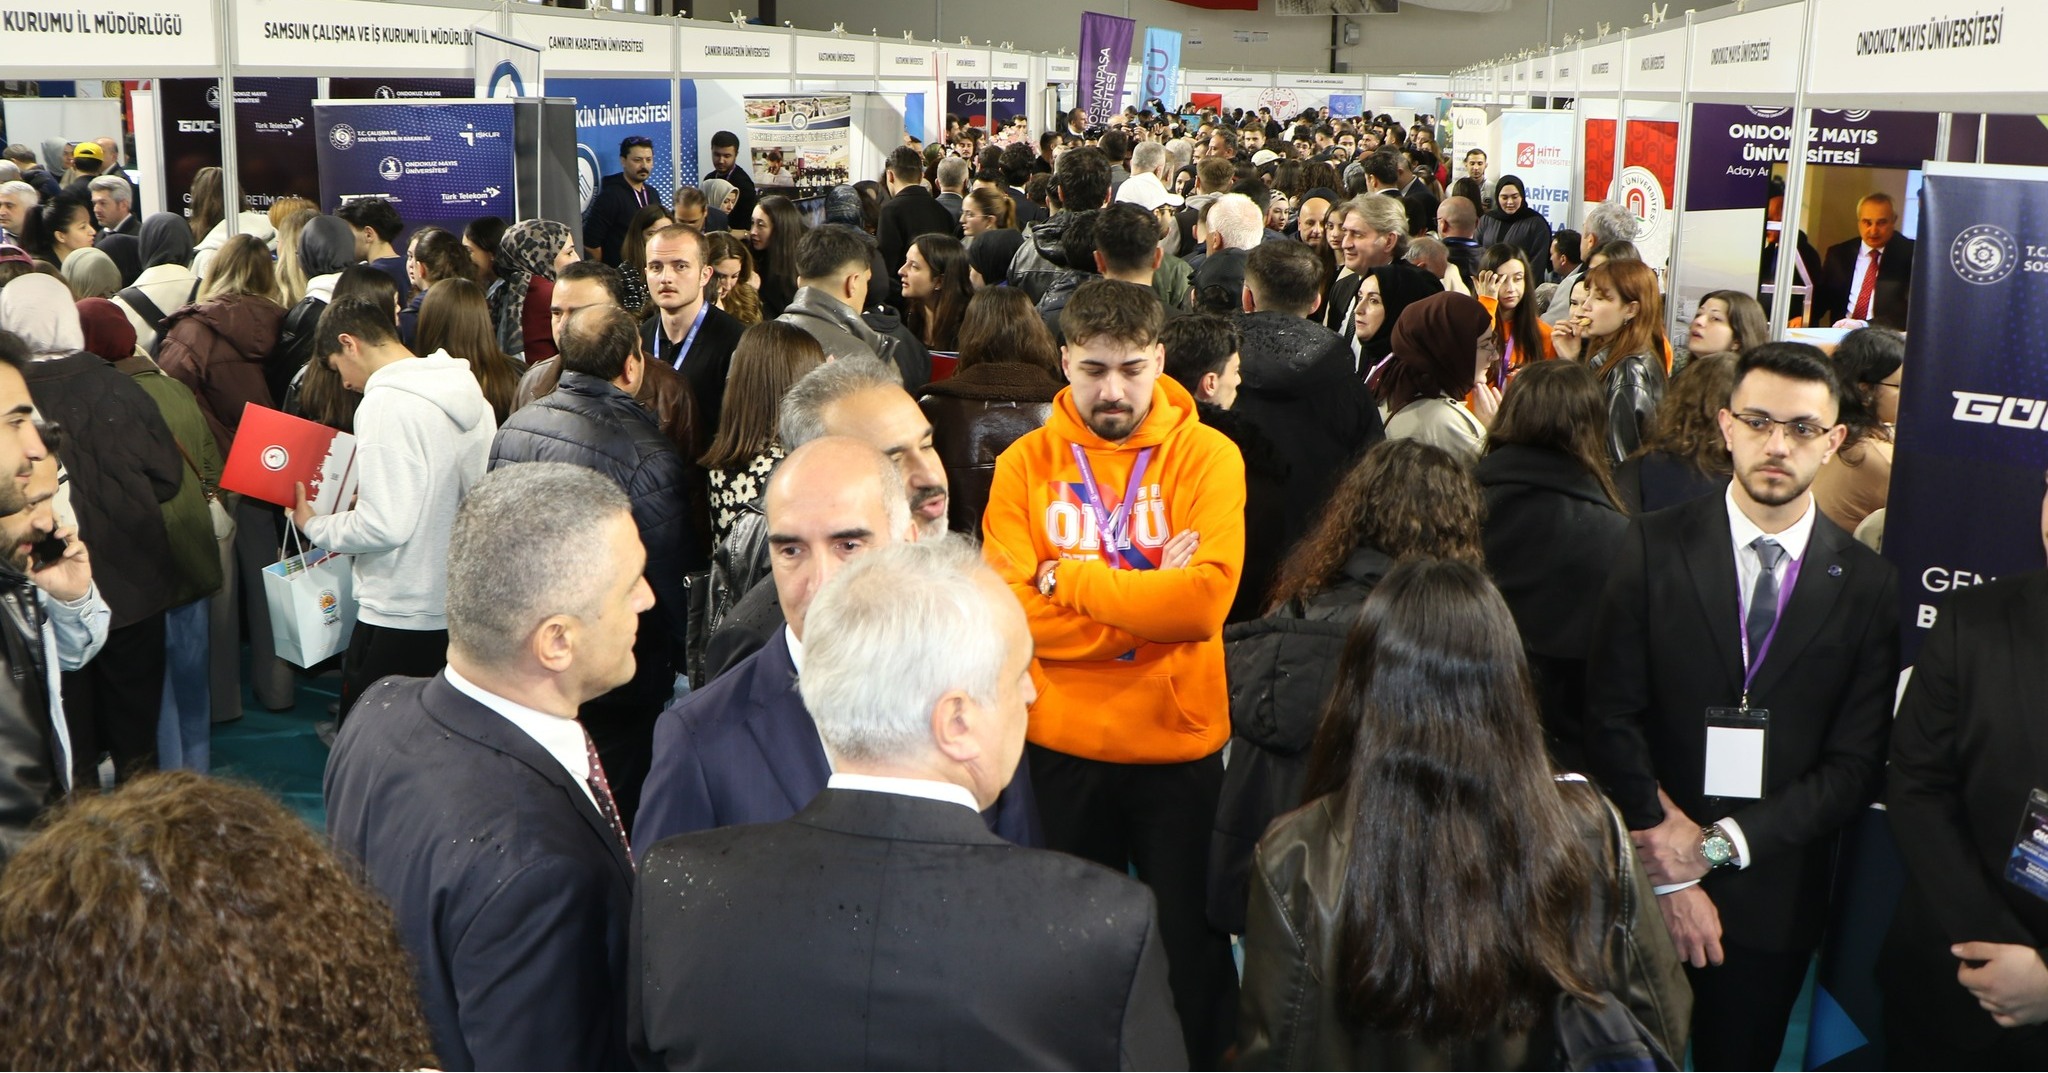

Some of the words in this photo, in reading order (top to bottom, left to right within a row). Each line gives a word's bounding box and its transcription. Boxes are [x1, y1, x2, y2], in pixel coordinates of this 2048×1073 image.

[3, 10, 74, 33] KURUMU
[77, 9, 91, 34] İL
[95, 11, 182, 36] MÜDÜRLÜĞÜ
[264, 22, 310, 40] SAMSUN
[312, 24, 356, 43] ÇALIŞMA
[357, 26, 370, 42] VE
[372, 24, 381, 44] İŞ
[382, 27, 420, 44] KURUMU
[421, 26, 429, 44] İL
[1856, 27, 1897, 56] ONDOKUZ
[1897, 24, 1927, 53] MAYIS
[1927, 6, 2004, 50] ÜNİVERSİTESİ
[548, 36, 574, 51] ÇANKIRI
[575, 36, 607, 51] KARATEKİN
[608, 37, 644, 52] ÜNİVERSİTESİ
[1087, 47, 1111, 128] OSMANPAŞA
[1100, 72, 1118, 125] ERSİTESİ
[254, 121, 268, 129] Türk
[268, 121, 294, 129] Telekom
[598, 101, 671, 127] ÜNİVERSİTESİ
[1728, 123, 1820, 143] ONDOKZ
[1821, 127, 1879, 145] MAYIS
[1537, 145, 1562, 158] HİTİT
[1742, 143, 1861, 165] ÜNİVSİTESİ
[1726, 165, 1756, 178] Aday
[245, 192, 275, 206] RETİM
[458, 192, 488, 200] Telekom
[1524, 184, 1570, 203] ARİYER
[1046, 483, 1171, 551] OMÜ
